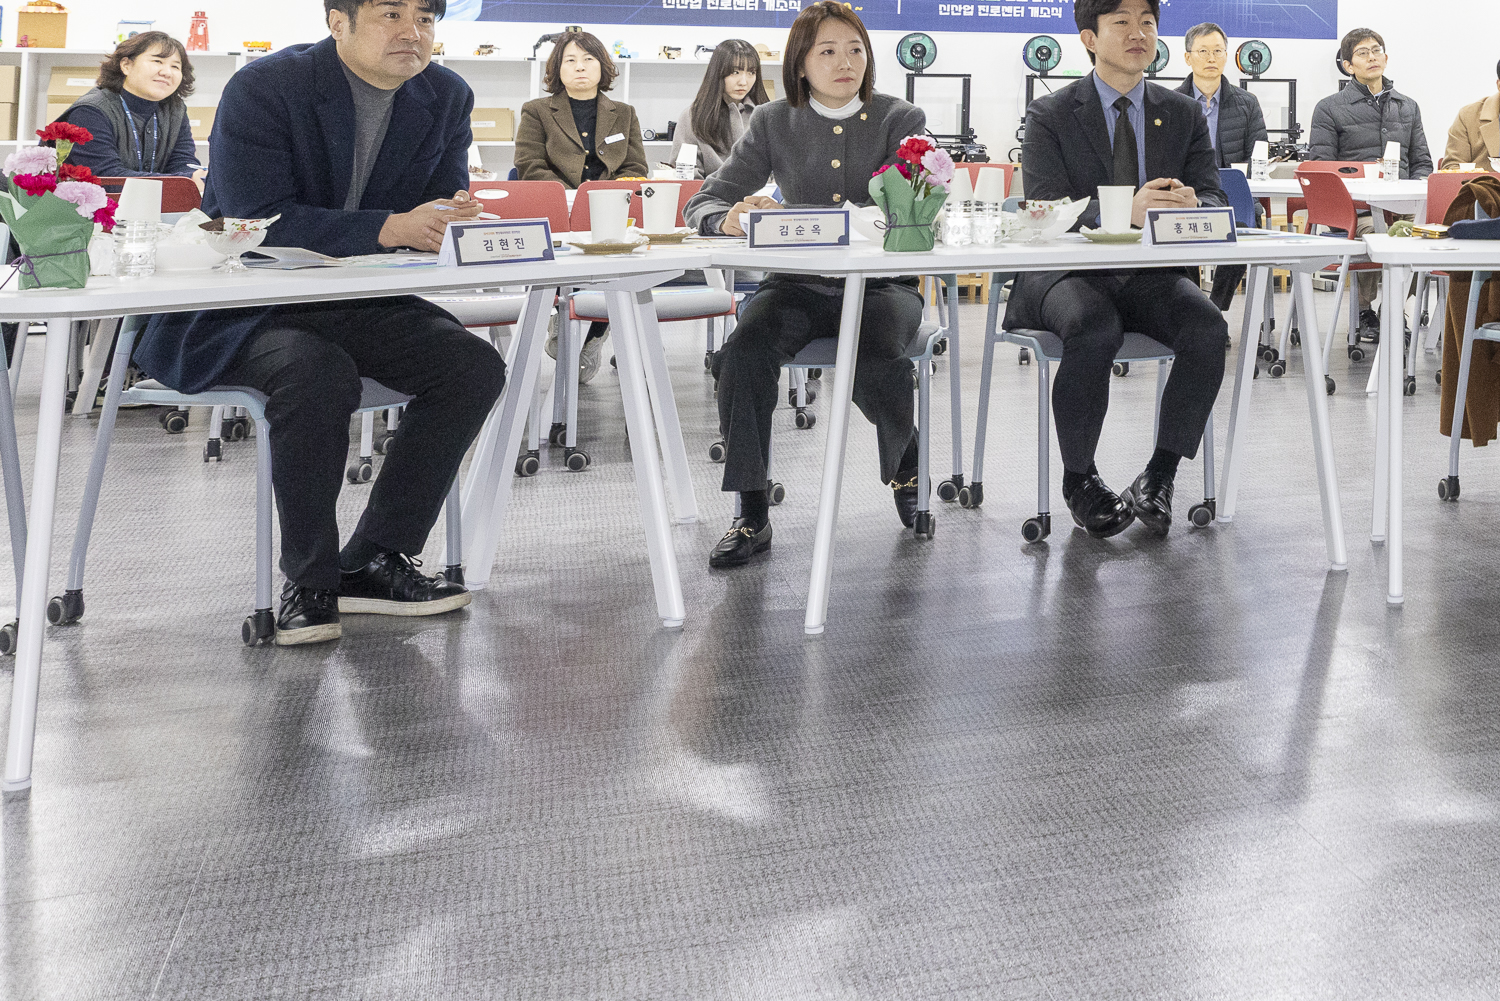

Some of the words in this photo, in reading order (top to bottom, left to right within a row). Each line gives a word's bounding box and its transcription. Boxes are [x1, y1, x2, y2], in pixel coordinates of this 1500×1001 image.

[938, 3, 974, 16] 신산업
[977, 5, 1025, 18] 진로센터
[1028, 6, 1063, 19] 개소식
